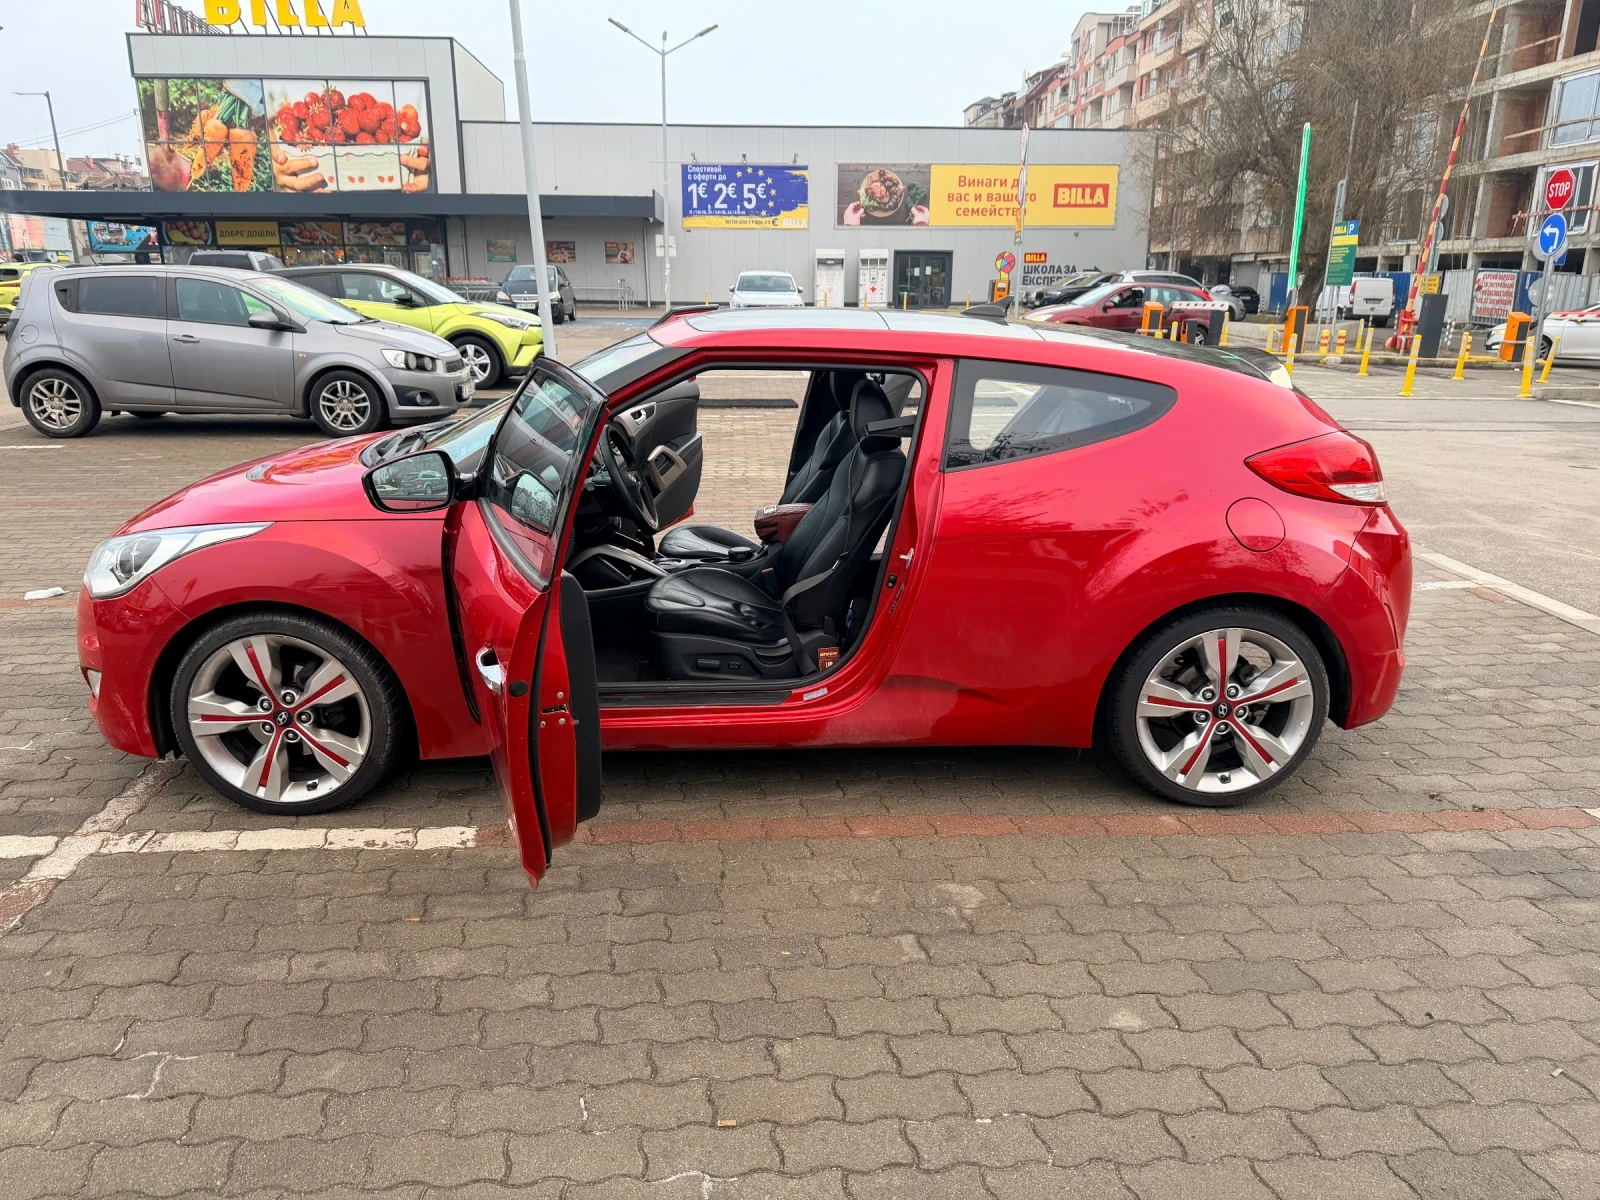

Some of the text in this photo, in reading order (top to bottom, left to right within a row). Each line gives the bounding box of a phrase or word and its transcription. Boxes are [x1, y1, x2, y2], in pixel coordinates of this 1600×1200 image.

[687, 165, 722, 173] Спестявай
[693, 173, 717, 182] оферти
[958, 175, 1007, 188] Винаги
[1548, 181, 1571, 198] STOP
[743, 183, 767, 209] 5€
[947, 192, 970, 203] вас
[974, 192, 982, 202] и
[1057, 187, 1106, 205] BILLA
[955, 204, 1027, 217] семейств
[782, 218, 807, 227] BILLA
[219, 230, 276, 239] ДОБРЕ ДОШЛИ
[1025, 253, 1046, 262] BILLA
[1023, 265, 1076, 274] ШКОЛА ЗА
[1022, 275, 1067, 286] ЕКСПЕР
